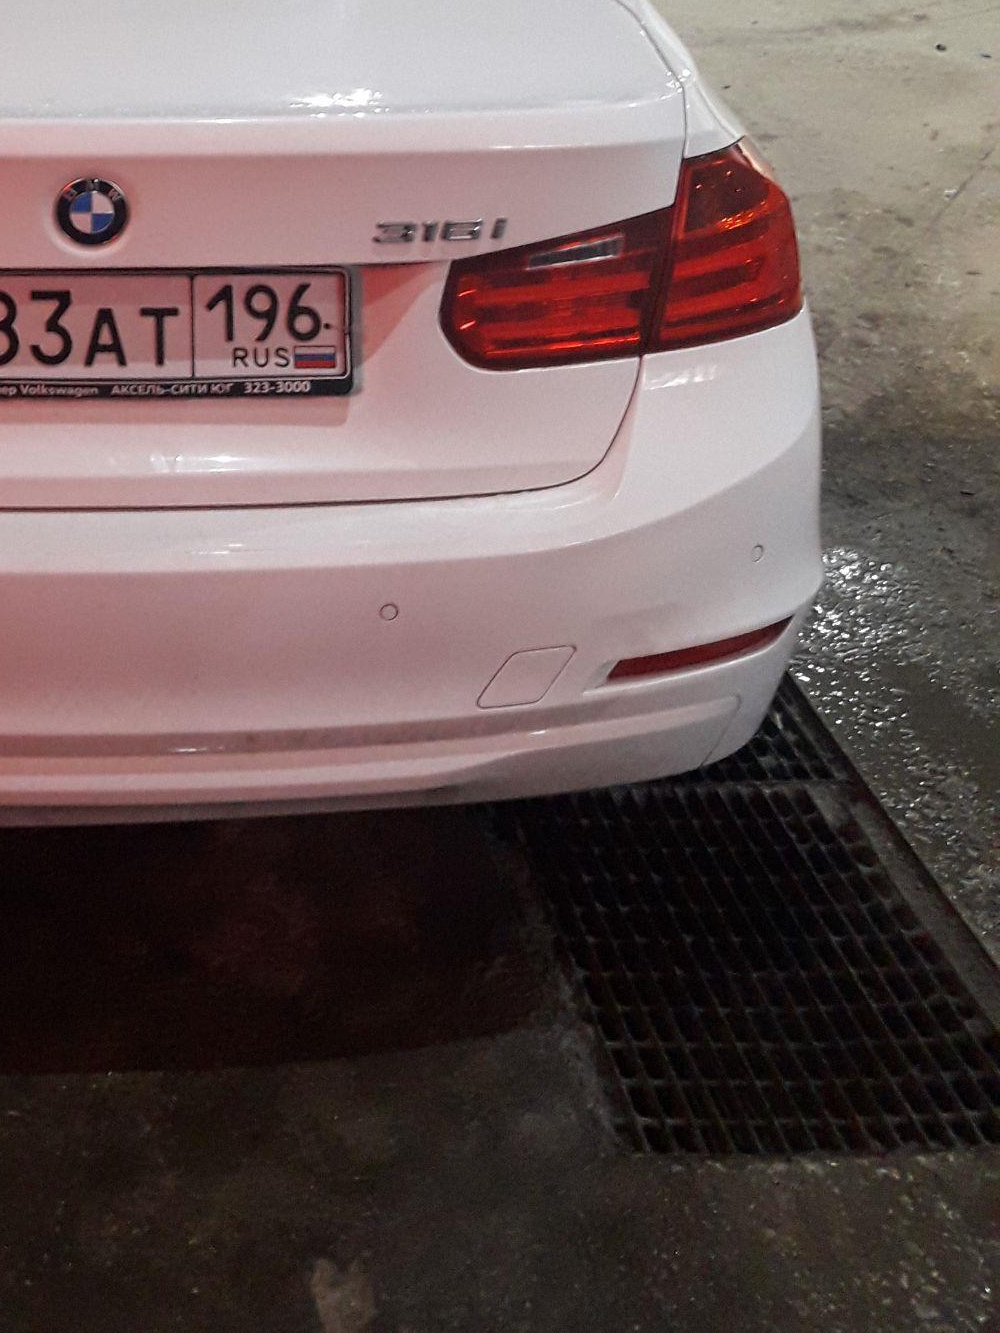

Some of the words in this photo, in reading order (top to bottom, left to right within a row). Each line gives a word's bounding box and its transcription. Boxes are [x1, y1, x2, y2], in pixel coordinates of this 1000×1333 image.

[206, 281, 320, 343] 196
[232, 347, 291, 370] RUS
[243, 380, 312, 395] 323-3000
